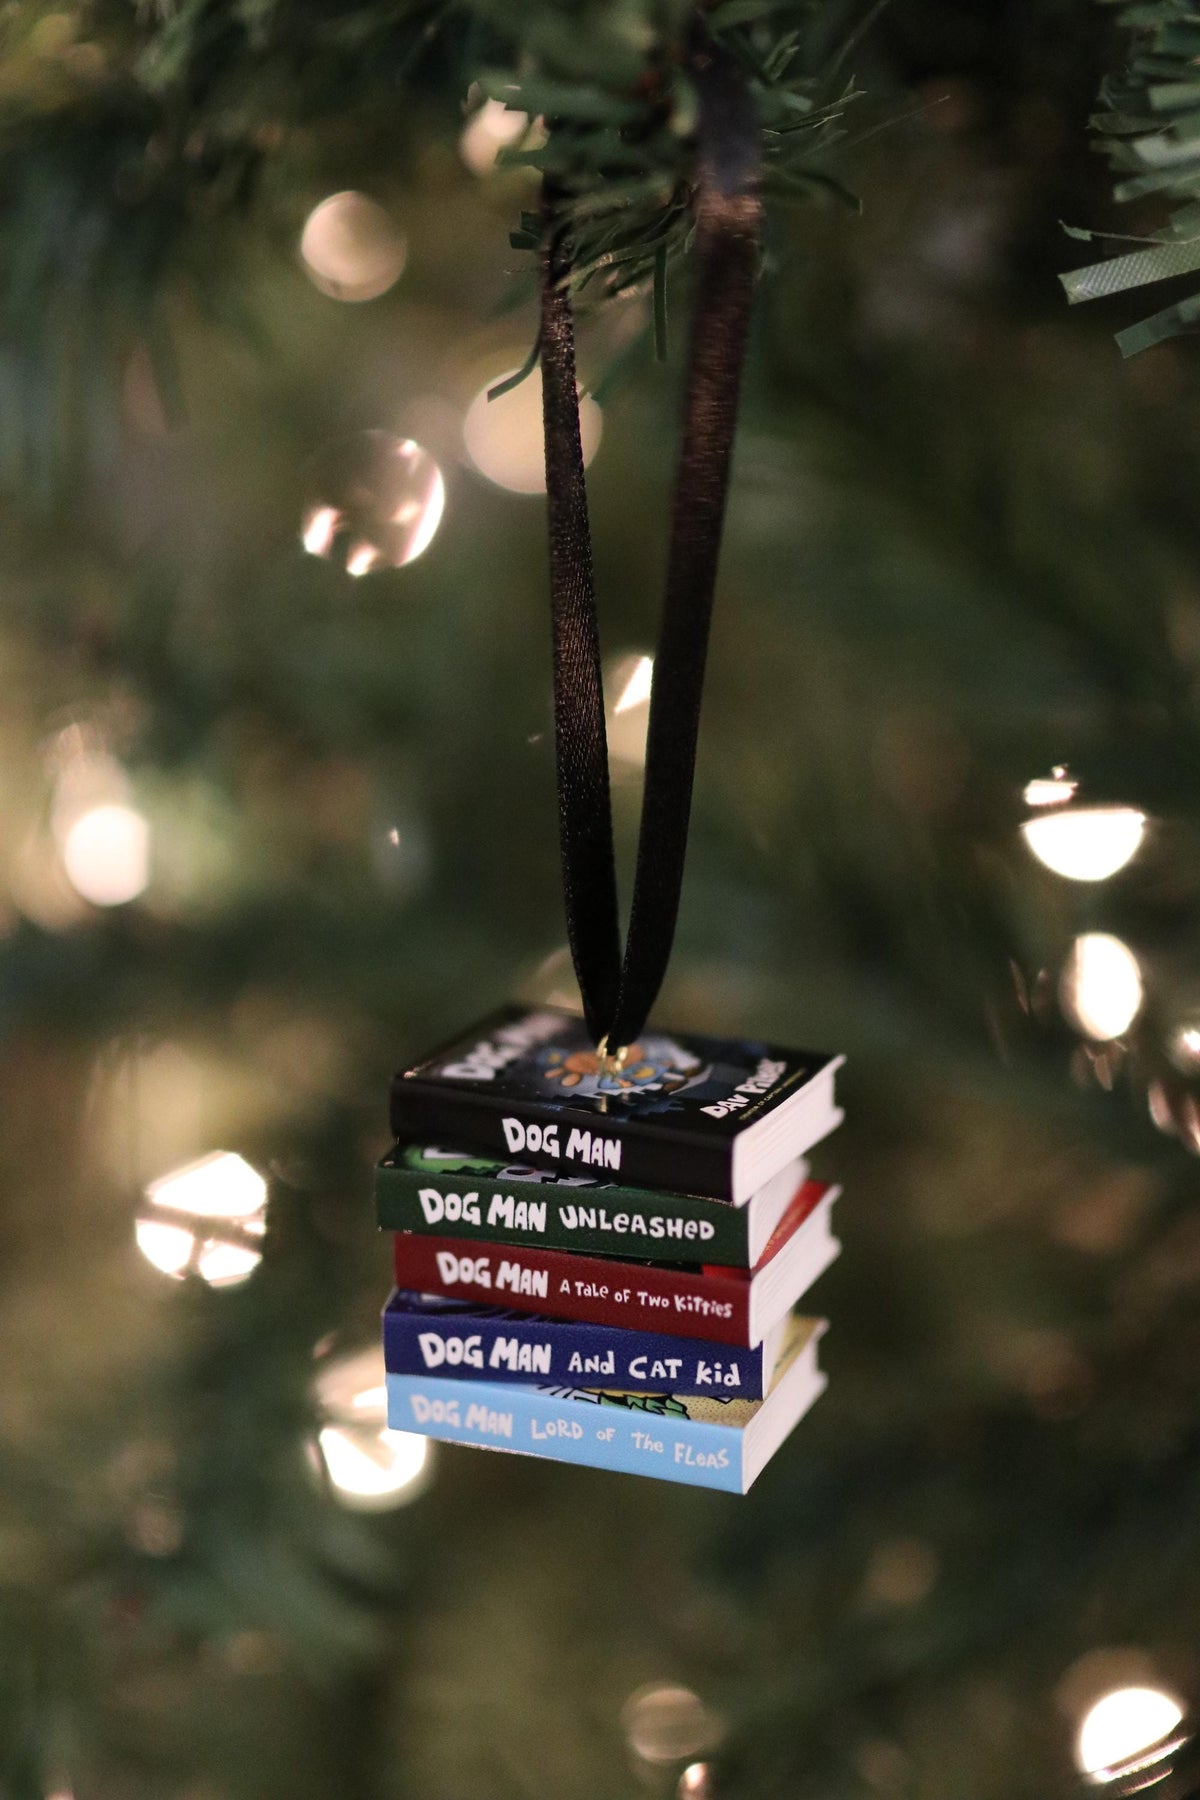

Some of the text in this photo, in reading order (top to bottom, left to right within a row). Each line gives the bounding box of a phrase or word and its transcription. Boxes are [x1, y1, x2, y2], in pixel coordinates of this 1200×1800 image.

[700, 1094, 750, 1119] DAV
[502, 1118, 622, 1171] DOG MAN
[418, 1188, 482, 1226] DOG
[486, 1194, 547, 1233] MAN
[435, 1251, 492, 1290] DOG
[495, 1260, 549, 1299] MAN
[559, 1279, 571, 1295] A
[418, 1332, 484, 1369] DOG
[489, 1336, 552, 1374] MAN
[628, 1356, 683, 1380] CAT
[410, 1394, 462, 1429] DOG
[464, 1403, 514, 1438] MAN
